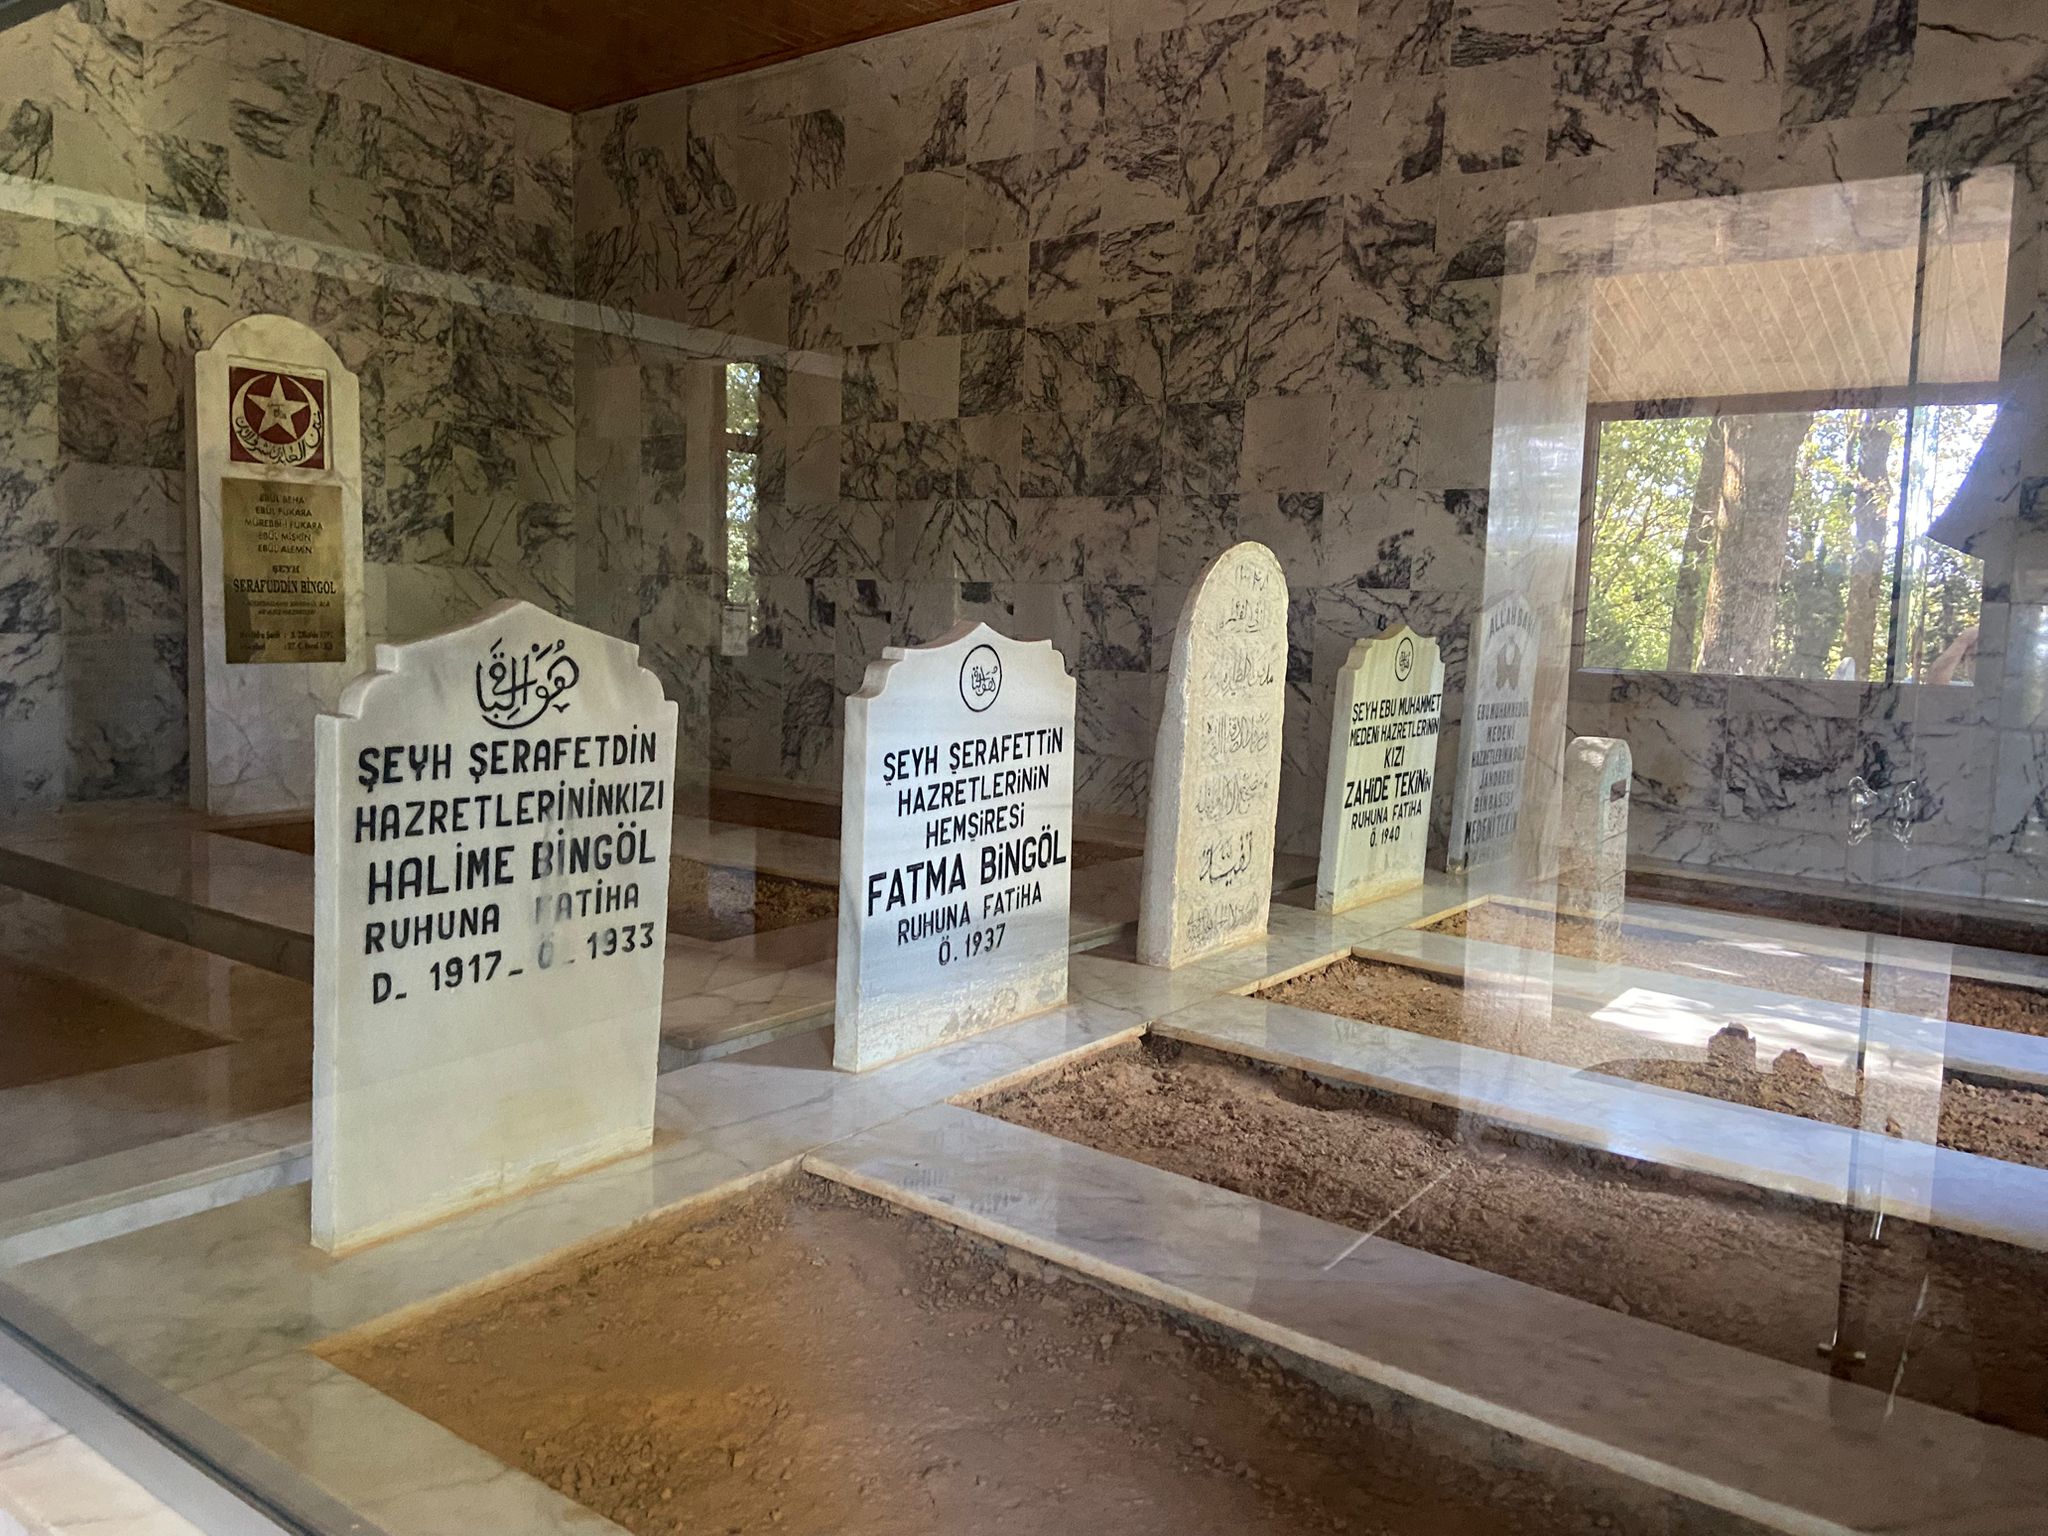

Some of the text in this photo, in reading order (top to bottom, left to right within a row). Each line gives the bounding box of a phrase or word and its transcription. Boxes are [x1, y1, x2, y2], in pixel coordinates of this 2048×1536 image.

[1352, 694, 1441, 725] ŞEYH EBU MUHAMMET
[358, 724, 657, 793] ŞEYH ŞERAFETDİN
[883, 727, 1063, 786] ŞEYH ŞERAFETTİN
[1384, 746, 1405, 769] KIZI
[898, 764, 1050, 817] HAZRETLERİNİN
[1344, 774, 1391, 809] ZAHİDE
[926, 802, 1024, 849] HEMŞİRESİ
[1351, 799, 1422, 831] RUHUNA FATİHA
[1381, 825, 1400, 844] 1940
[368, 821, 656, 905] HALİME BİNGÖL
[867, 824, 1067, 917] FATMA BİNGÖL
[364, 879, 639, 955] RUHUNA FATİHA
[897, 881, 1042, 946] RUHUNA FATİHA
[587, 922, 655, 960] 1933
[965, 922, 1006, 958] 1937
